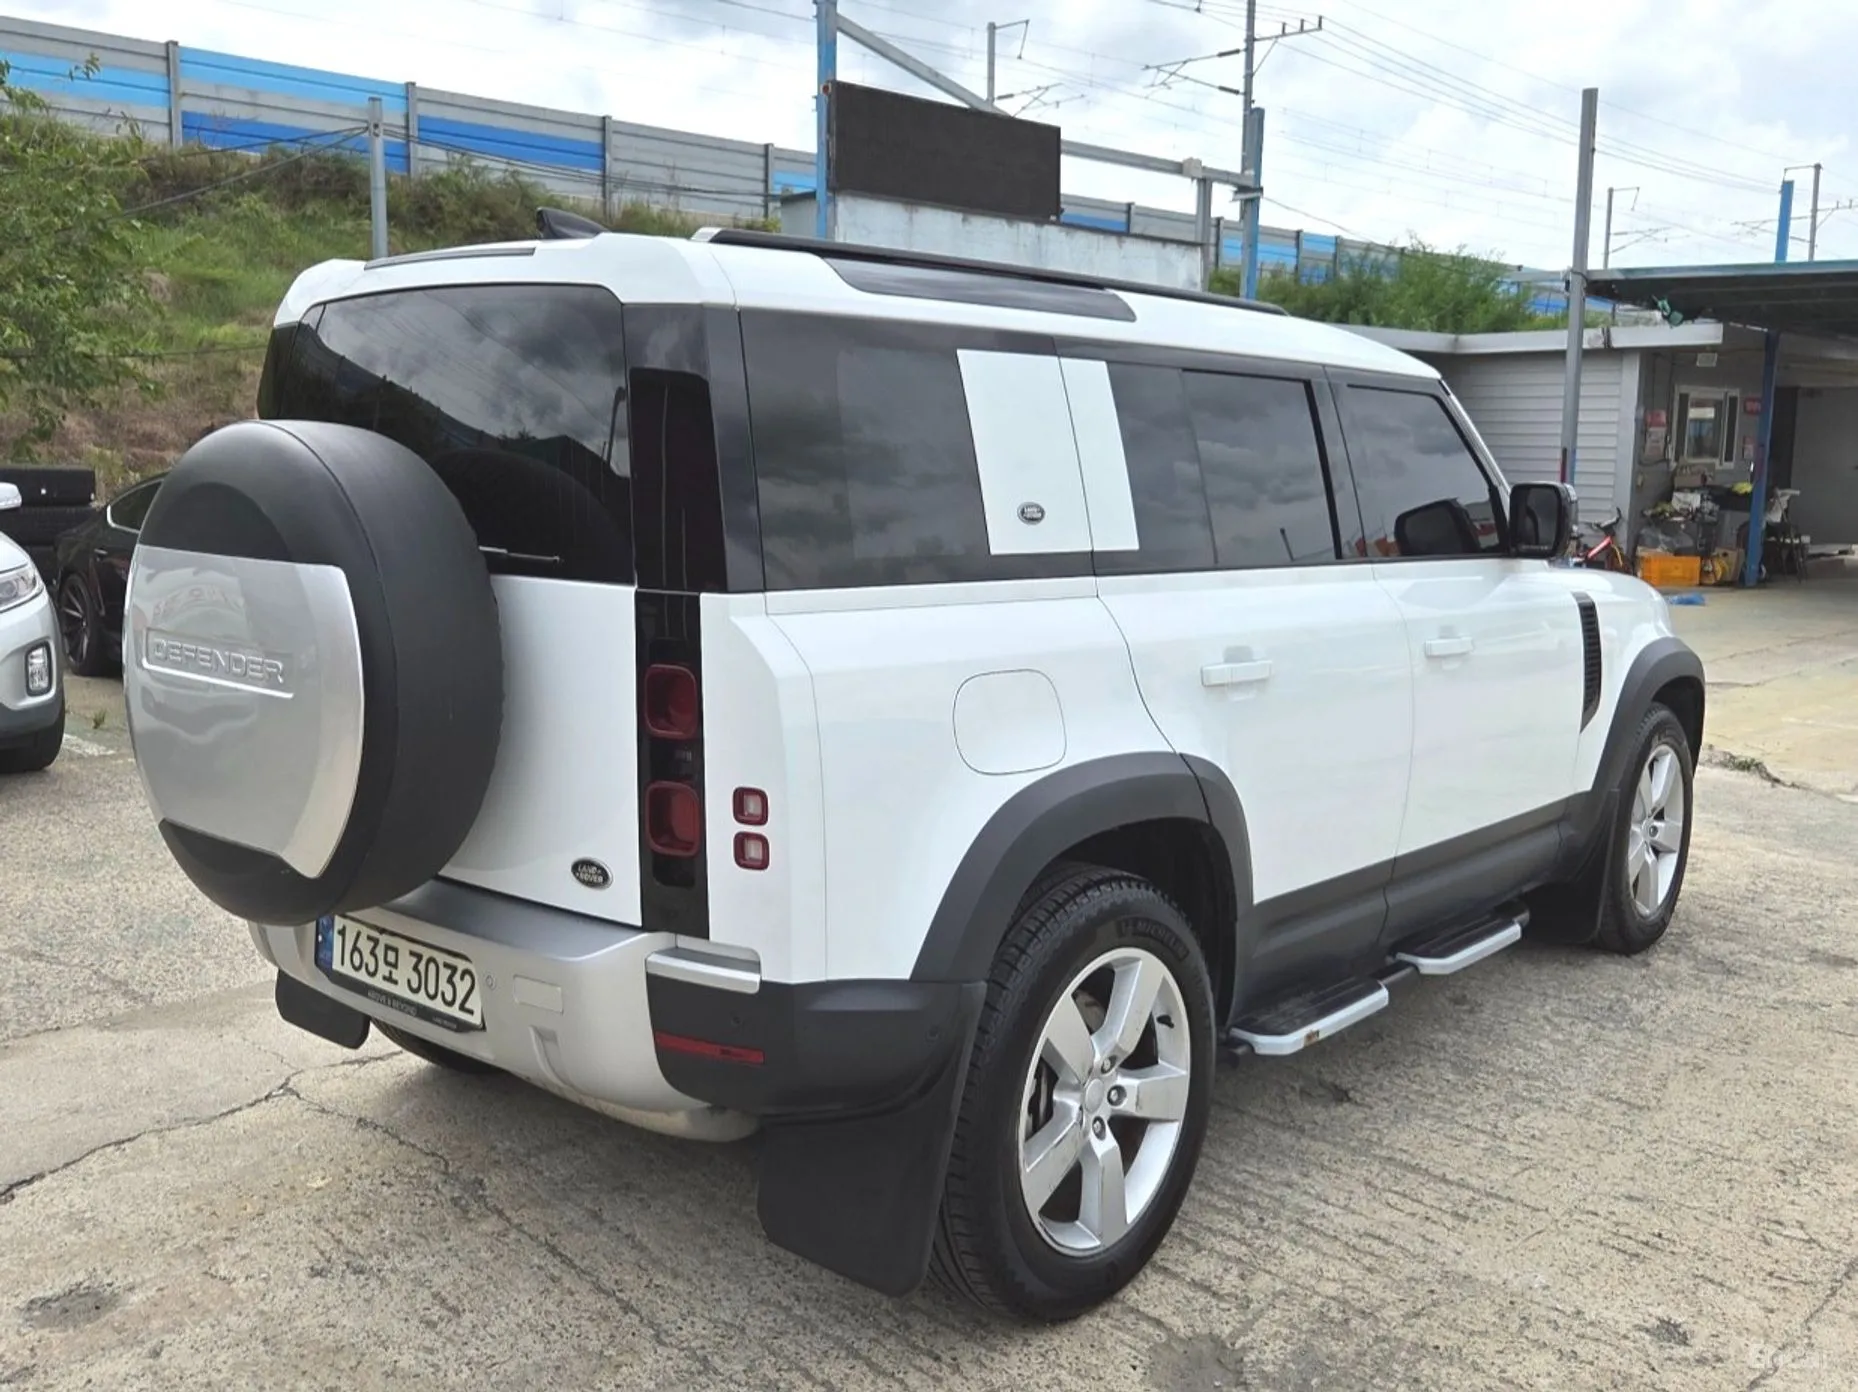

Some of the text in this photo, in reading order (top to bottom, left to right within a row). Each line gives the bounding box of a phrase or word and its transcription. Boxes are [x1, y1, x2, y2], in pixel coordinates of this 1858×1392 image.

[154, 638, 284, 684] DEFENDER
[337, 925, 477, 1016] 163모 3032
